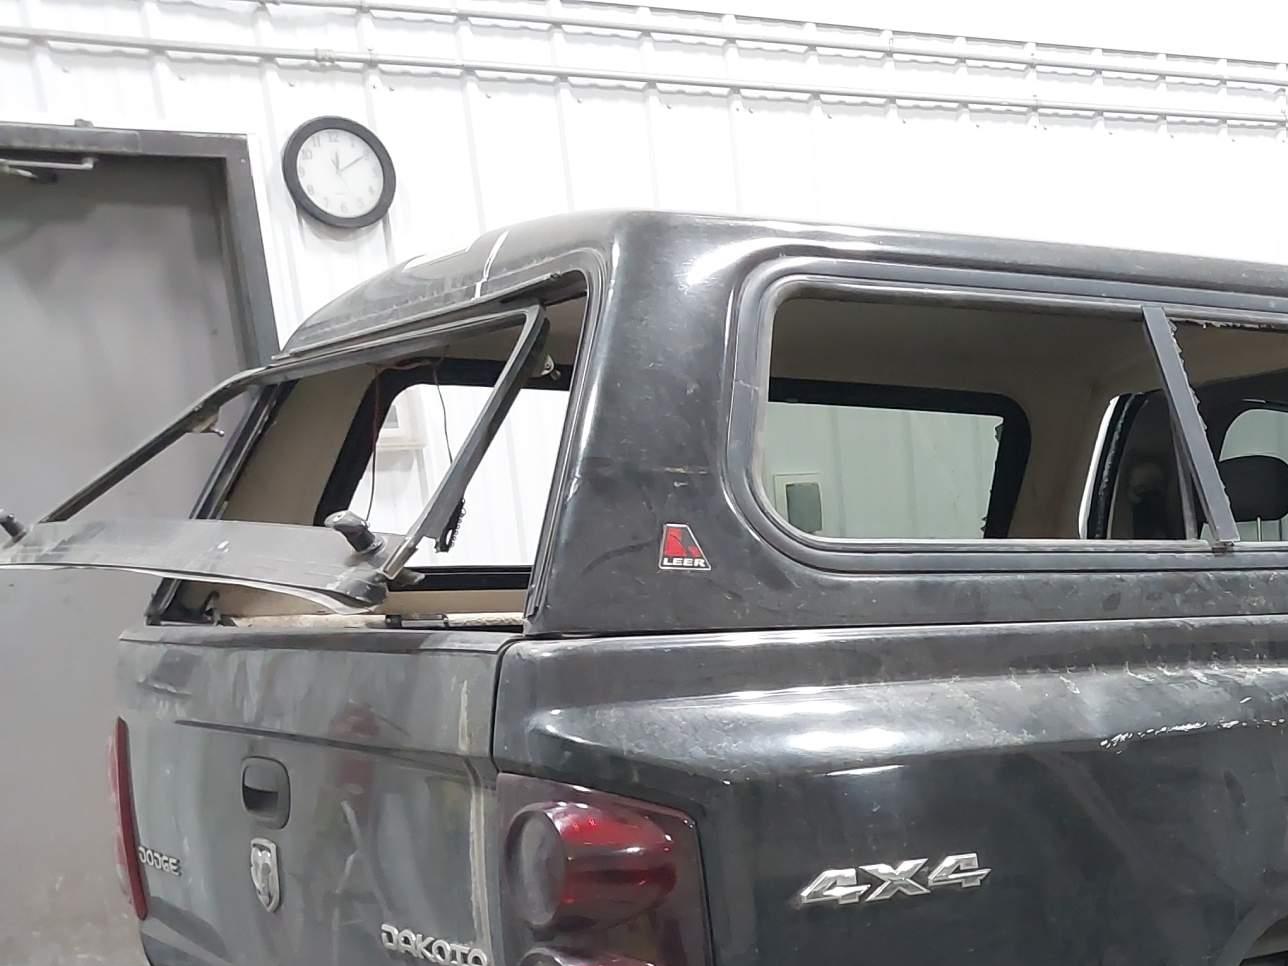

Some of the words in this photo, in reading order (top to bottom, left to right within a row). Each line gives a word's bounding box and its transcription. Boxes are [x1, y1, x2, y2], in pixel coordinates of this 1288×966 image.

[662, 557, 706, 567] LEER
[138, 846, 182, 876] DODGE
[800, 852, 992, 905] 4X4
